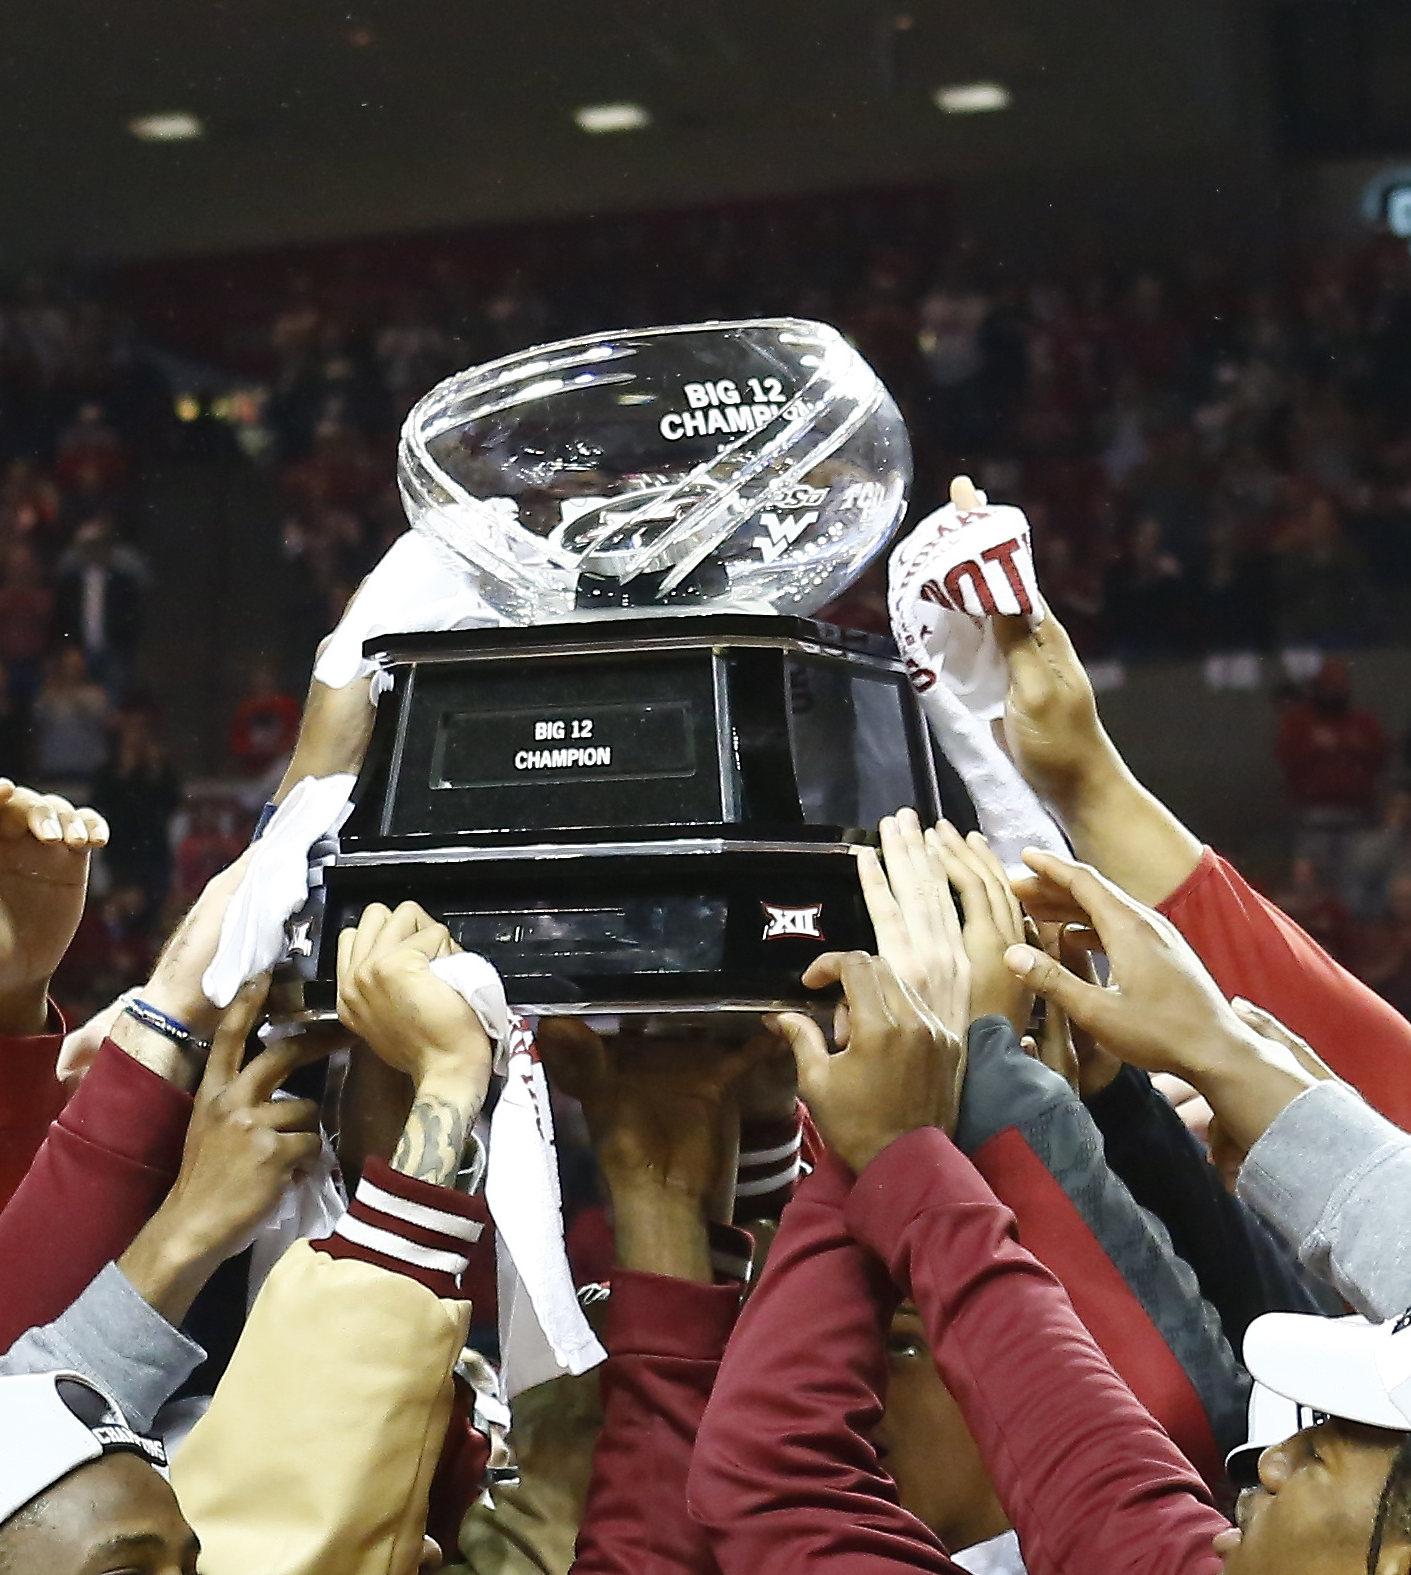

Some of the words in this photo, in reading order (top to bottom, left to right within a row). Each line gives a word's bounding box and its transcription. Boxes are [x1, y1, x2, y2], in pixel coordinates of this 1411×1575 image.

[683, 379, 741, 408] BIG
[747, 378, 787, 403] 12
[534, 720, 565, 740] BIG
[571, 719, 593, 738] 12
[514, 746, 611, 769] CHAMPION
